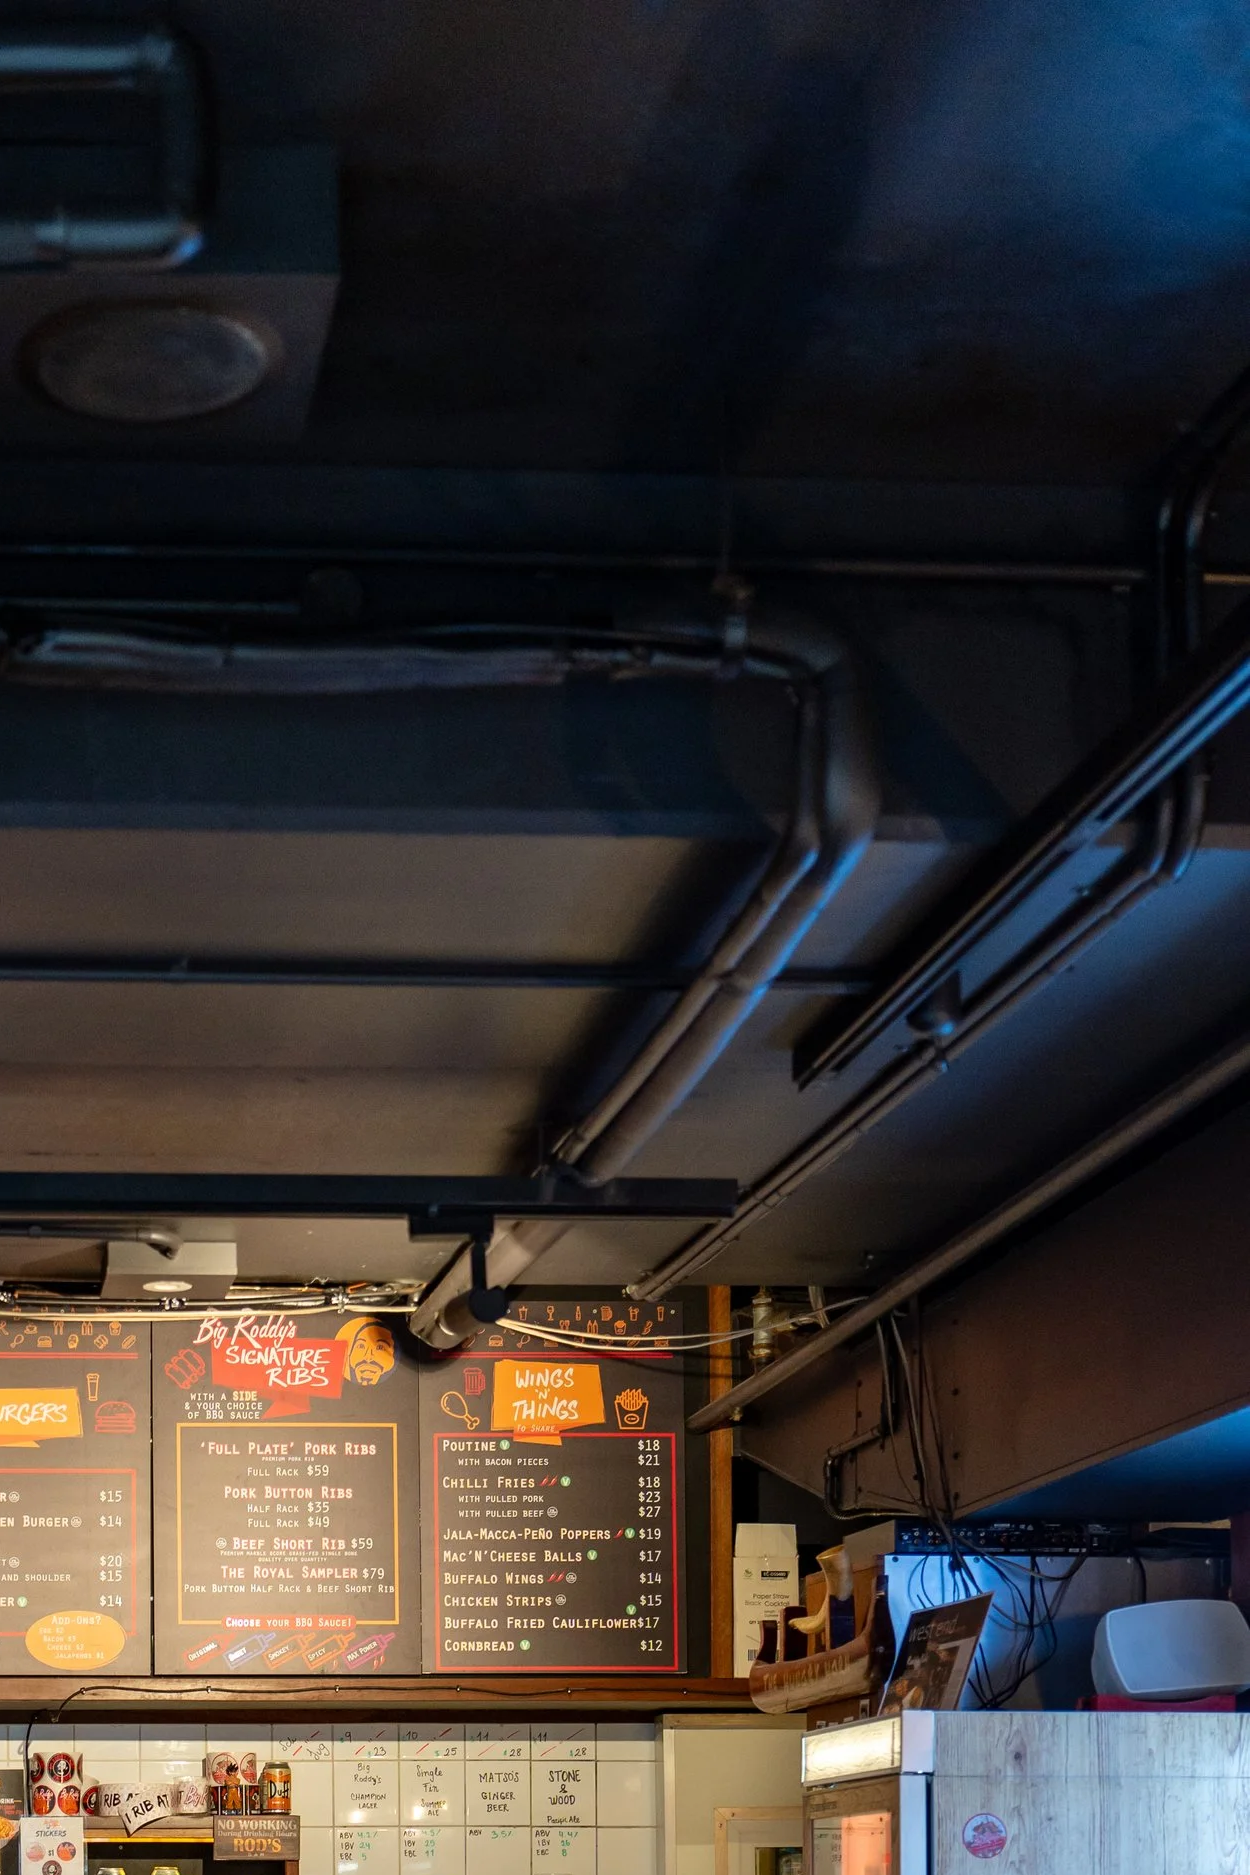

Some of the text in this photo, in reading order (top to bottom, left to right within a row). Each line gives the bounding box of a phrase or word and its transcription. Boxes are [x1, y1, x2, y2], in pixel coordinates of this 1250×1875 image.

[225, 1344, 331, 1366] SIGNATURE
[266, 1367, 329, 1388] RIBS
[515, 1367, 575, 1389] WINGS
[512, 1399, 579, 1421] THINGS
[304, 1441, 337, 1455] PORK
[345, 1442, 376, 1456] RIBS
[442, 1439, 660, 1452] POUTINE $18
[247, 1464, 329, 1477] FULL RACK $59
[442, 1476, 661, 1489] CHILLI FRIES $18
[99, 1490, 122, 1503] $15
[22, 1514, 69, 1528] BURGER
[99, 1515, 122, 1528] $14
[232, 1536, 373, 1550] BEEF SHORT RIB $59
[544, 1550, 582, 1562] BALLS
[639, 1550, 662, 1562] $17
[220, 1565, 385, 1580] THE ROYAL SAMPLER $79
[99, 1594, 123, 1607] $14
[443, 1594, 662, 1607] CHICKEN STRIPS $15
[444, 1639, 663, 1652] CORNBREAD $12
[548, 1769, 582, 1783] STONE
[481, 1791, 516, 1801] GINGER
[548, 1795, 576, 1806] WOOD
[486, 1803, 510, 1813] BEER
[217, 1819, 297, 1831] NO WORKING
[35, 1829, 67, 1838] STICKERS
